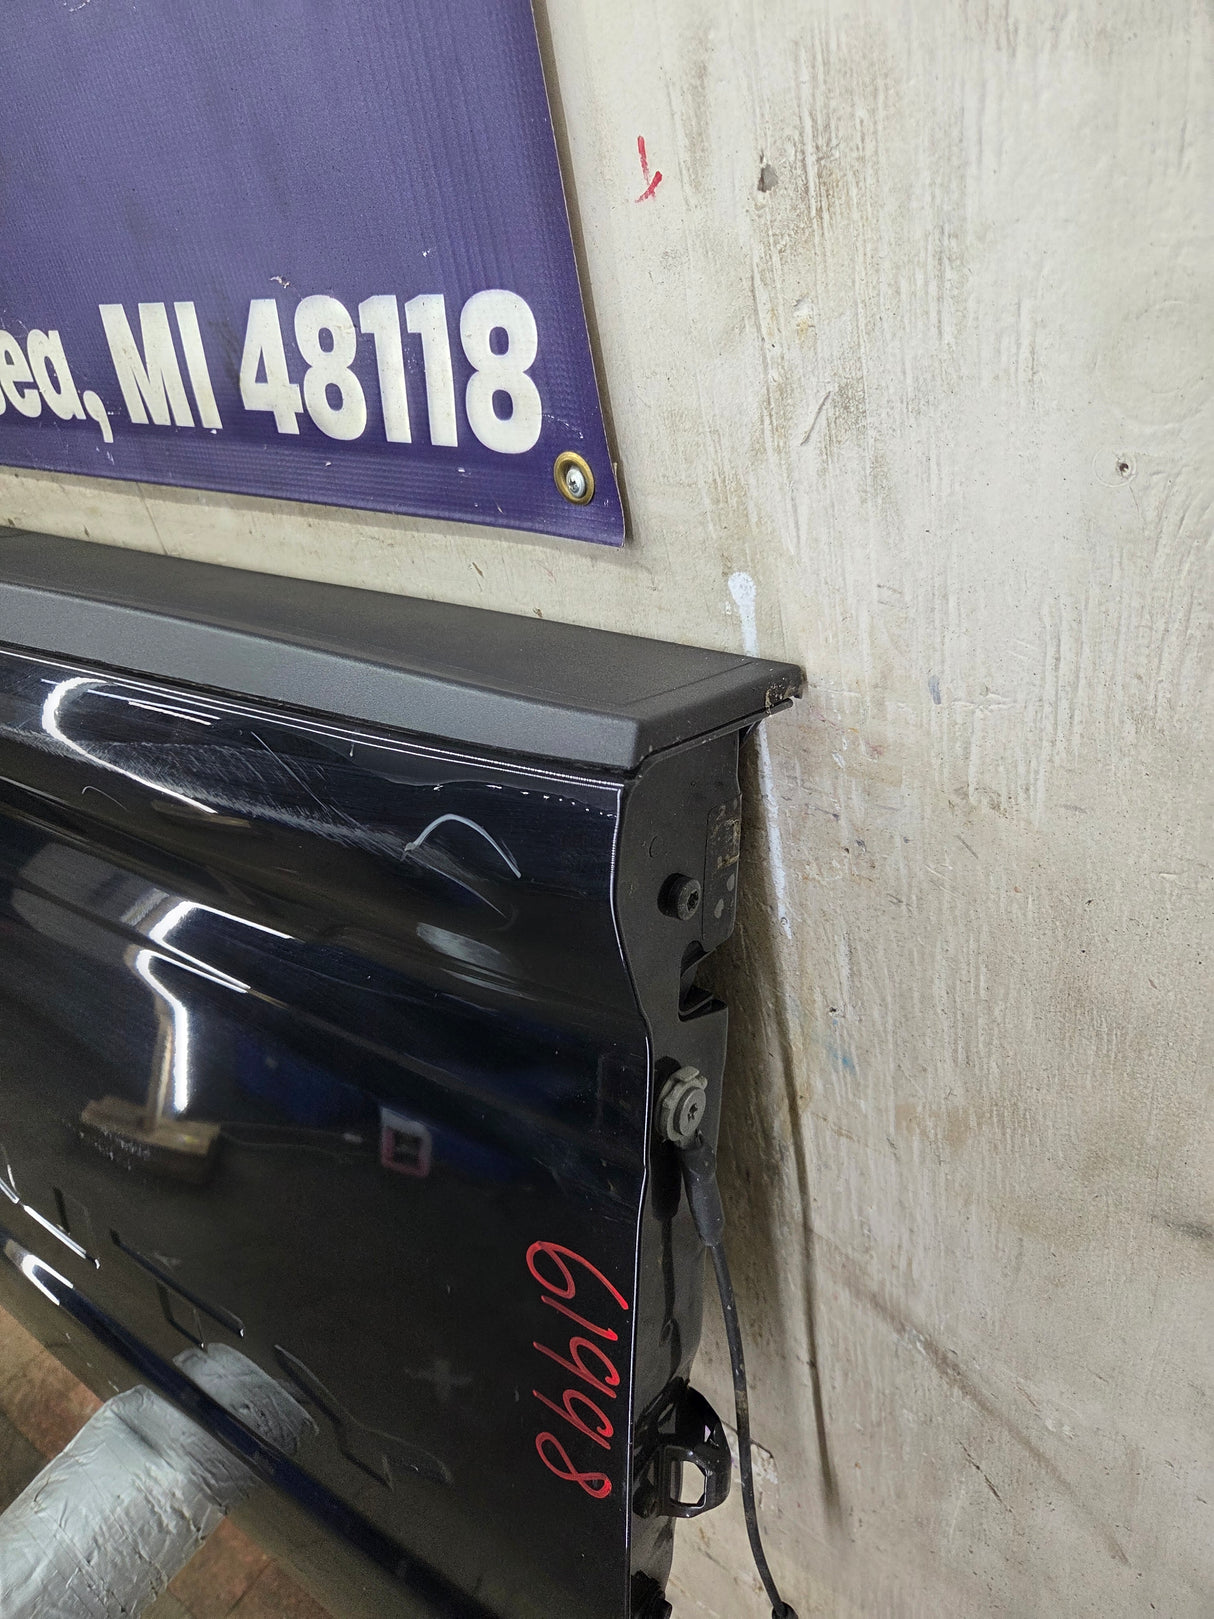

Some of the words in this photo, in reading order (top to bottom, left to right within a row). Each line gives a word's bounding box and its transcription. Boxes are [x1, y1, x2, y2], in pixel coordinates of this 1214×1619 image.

[0, 329, 114, 443] ea,
[99, 301, 223, 429] MI
[239, 289, 543, 455] 48118
[526, 1240, 629, 1499] 61998
